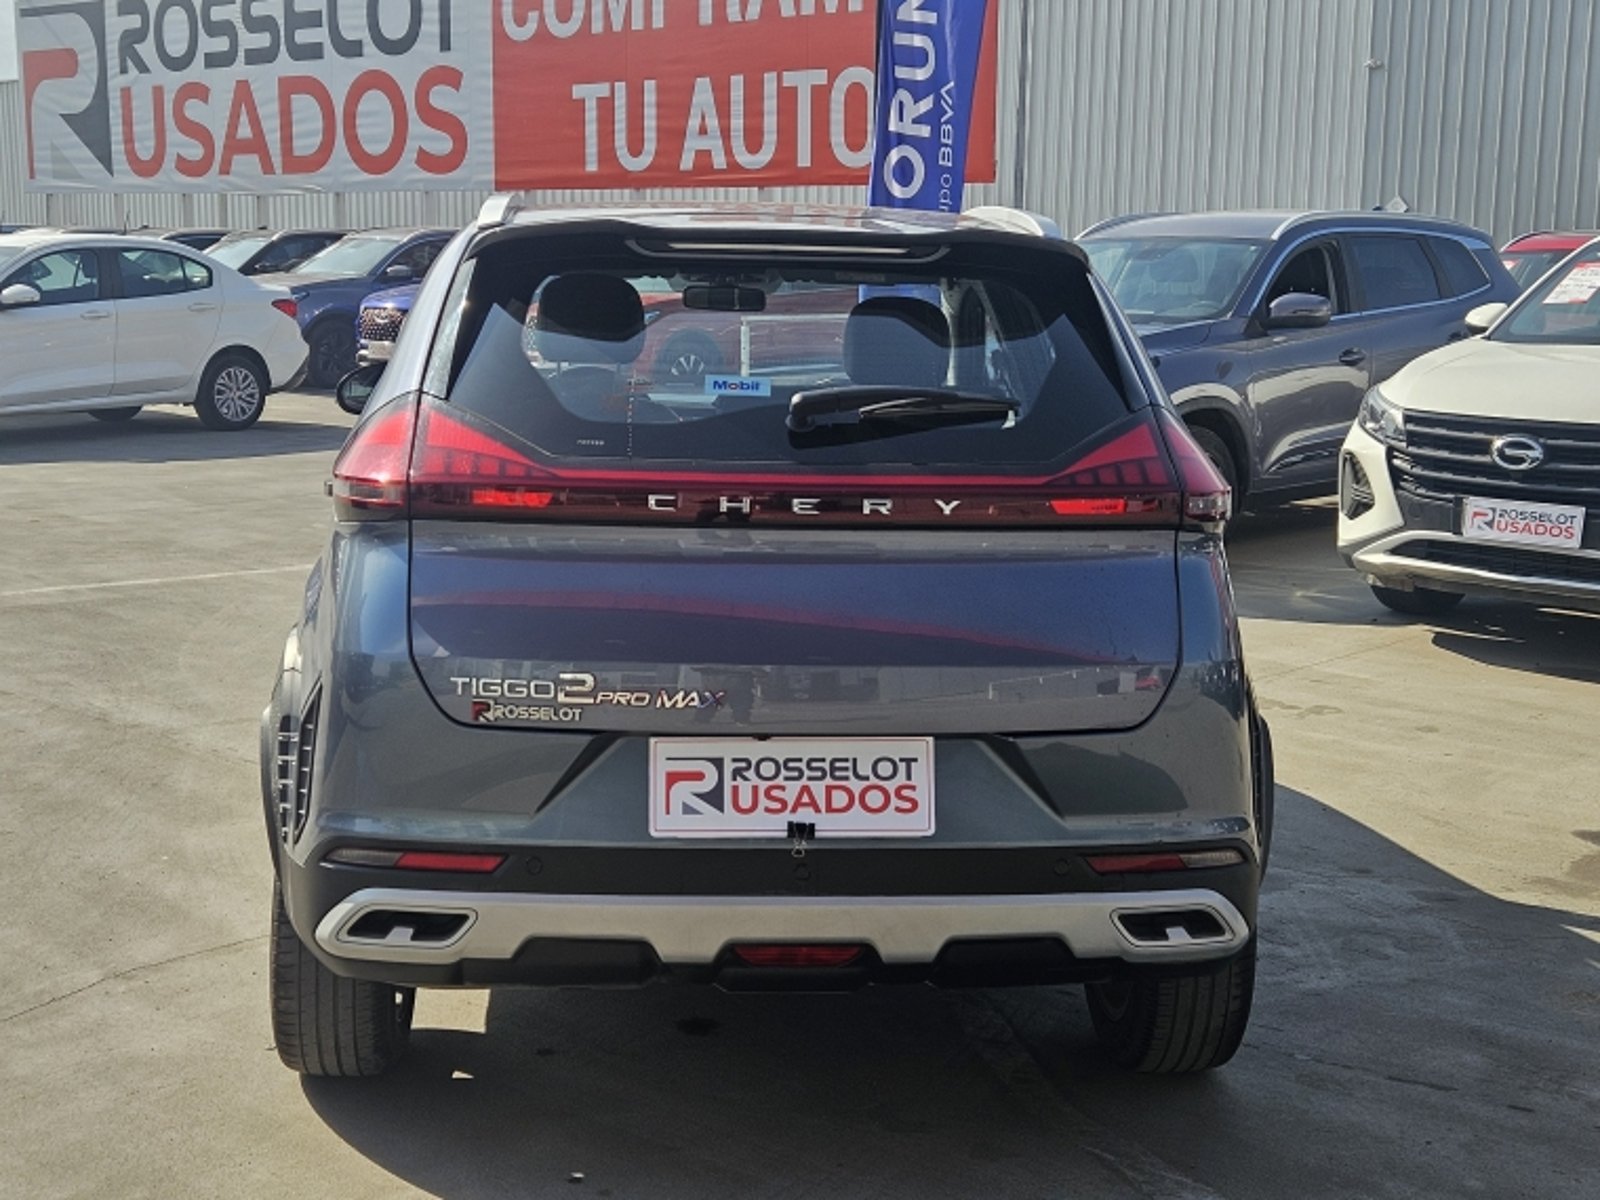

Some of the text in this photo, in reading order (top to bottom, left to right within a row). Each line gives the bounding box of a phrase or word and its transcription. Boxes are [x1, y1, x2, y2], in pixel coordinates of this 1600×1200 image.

[117, 0, 453, 74] ROSSELOT
[119, 65, 469, 178] USADOS
[572, 67, 875, 172] TU AUTO
[938, 80, 955, 167] BBVA
[713, 380, 760, 391] Mobil
[648, 494, 961, 515] CHERY
[1498, 508, 1577, 526] ROSSELOT
[1496, 519, 1574, 540] USADOS
[595, 691, 650, 707] PRO
[655, 690, 725, 709] MAX
[493, 704, 583, 721] ROSSELOT
[730, 757, 919, 783] ROSSELOT
[730, 784, 919, 815] USADOS
